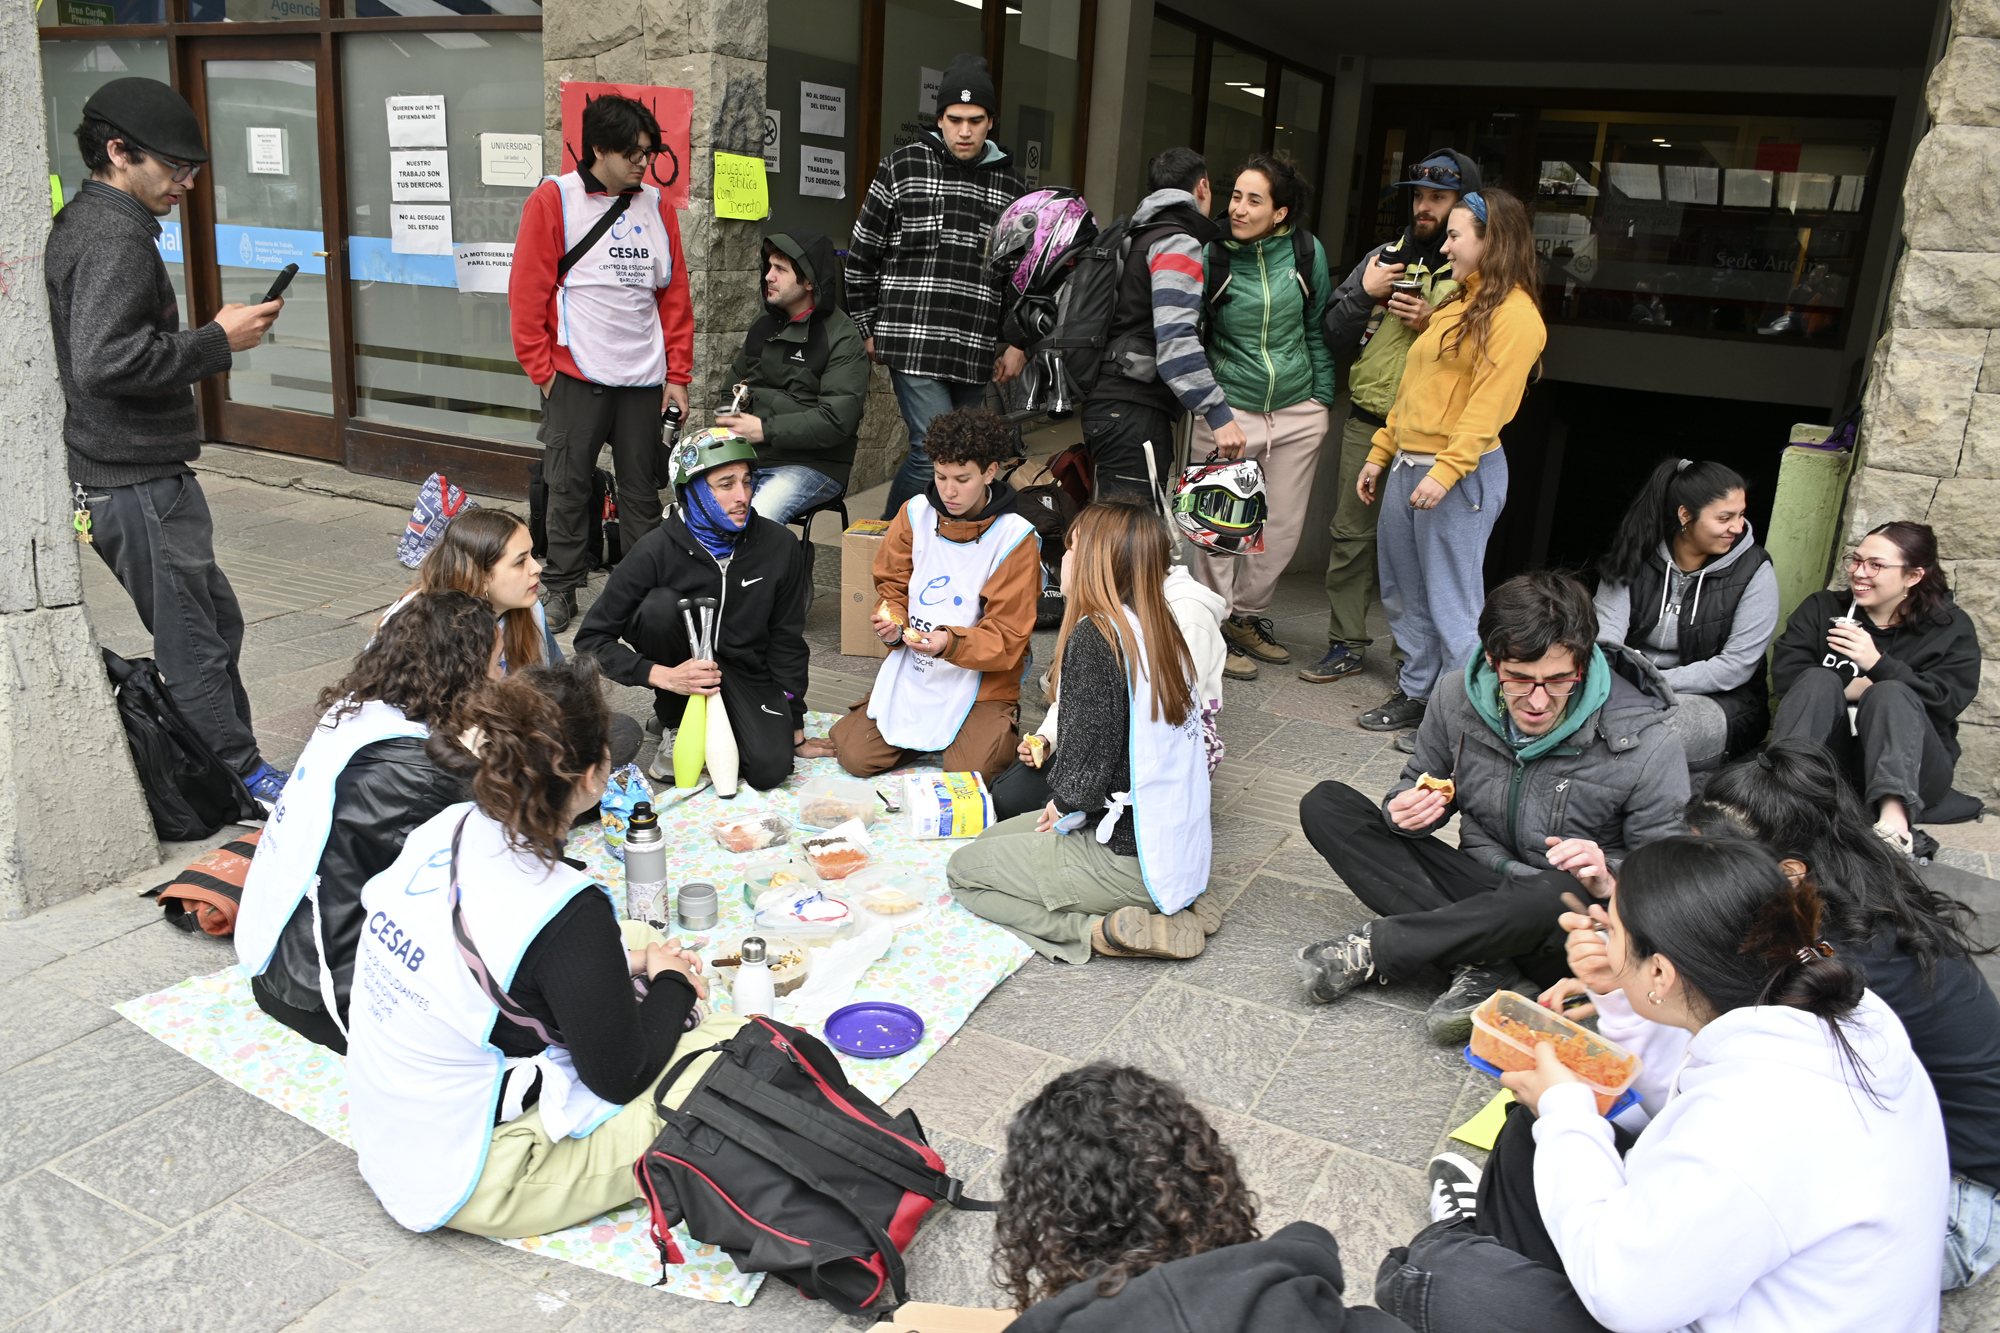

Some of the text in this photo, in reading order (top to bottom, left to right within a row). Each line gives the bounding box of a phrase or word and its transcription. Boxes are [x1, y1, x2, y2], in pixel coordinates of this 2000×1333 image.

[85, 6, 107, 18] Cardio
[271, 0, 320, 17] Agencia
[819, 94, 842, 103] DESGUACE
[819, 103, 837, 112] ESTADO
[490, 142, 533, 151] UNIVERSIDAD
[814, 156, 834, 164] NUESTRO
[807, 166, 840, 176] TRABAJO SON
[815, 177, 842, 187] DERECHOS.
[608, 246, 650, 259] CESAB
[256, 254, 283, 265] Argentina
[1714, 251, 1758, 270] Sede
[369, 911, 426, 973] CESAB
[380, 965, 431, 1012] ESTUDIANTES
